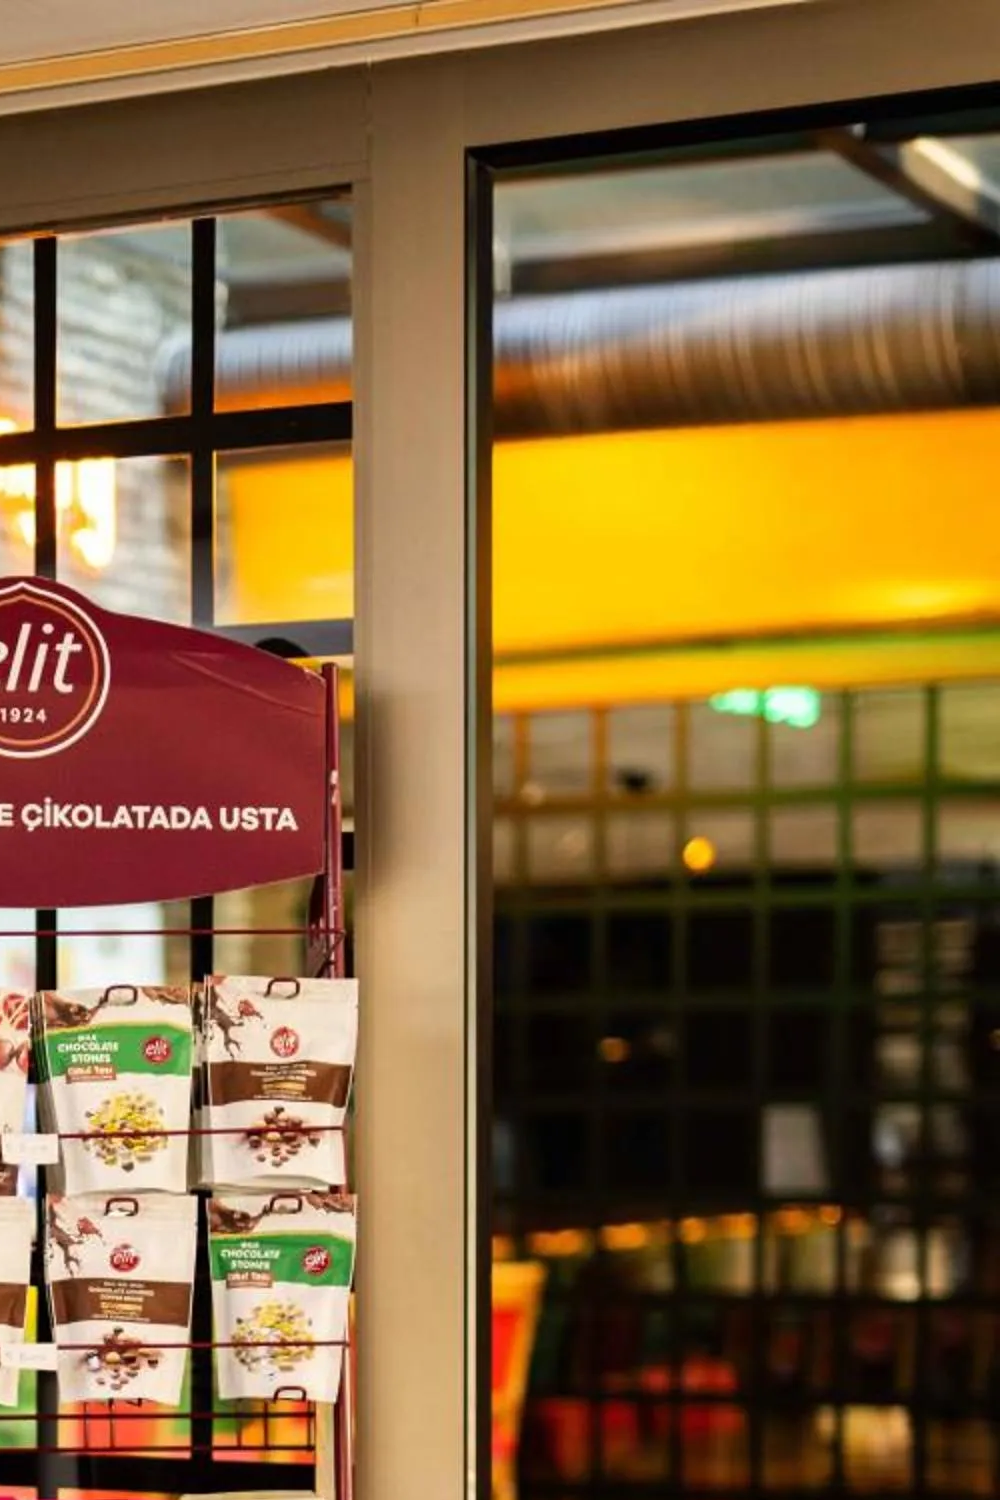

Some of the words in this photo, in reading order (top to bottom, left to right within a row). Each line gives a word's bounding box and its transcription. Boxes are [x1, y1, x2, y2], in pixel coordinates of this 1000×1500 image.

[0, 706, 49, 725] 1924
[20, 796, 213, 832] ÇİKOLATADA
[219, 806, 299, 832] USTA
